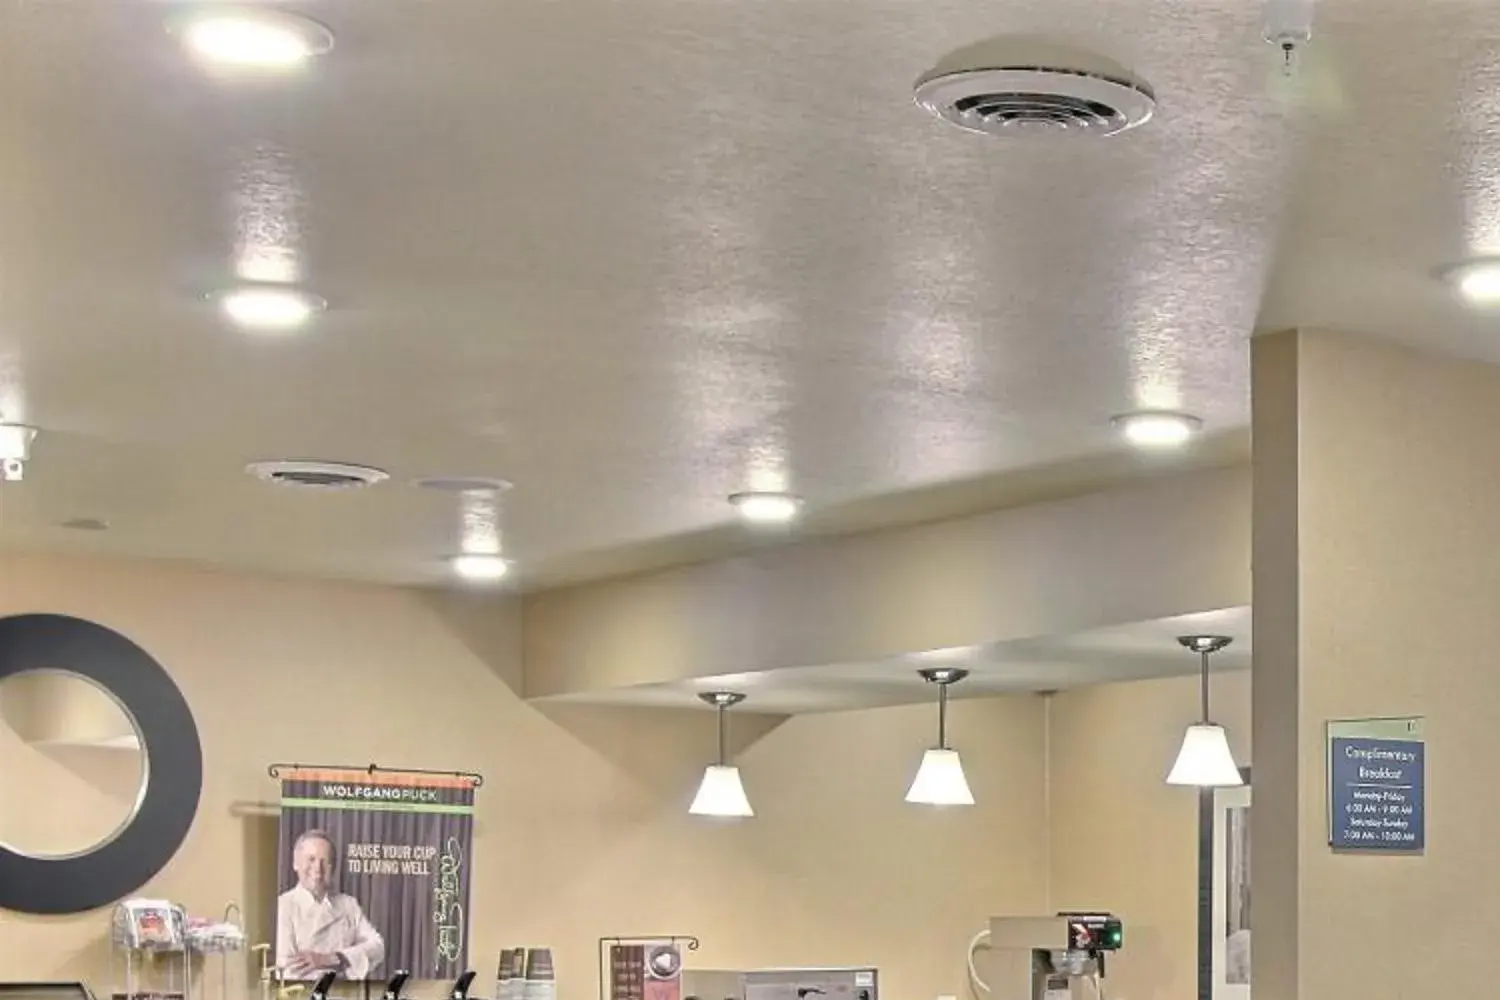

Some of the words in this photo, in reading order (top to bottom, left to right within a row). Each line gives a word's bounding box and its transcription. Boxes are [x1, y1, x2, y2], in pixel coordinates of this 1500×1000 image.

[347, 843, 380, 859] RAISE
[381, 845, 412, 859] YOUR
[413, 846, 437, 861] CUP
[347, 860, 361, 873] TO
[401, 861, 432, 876] WELL
